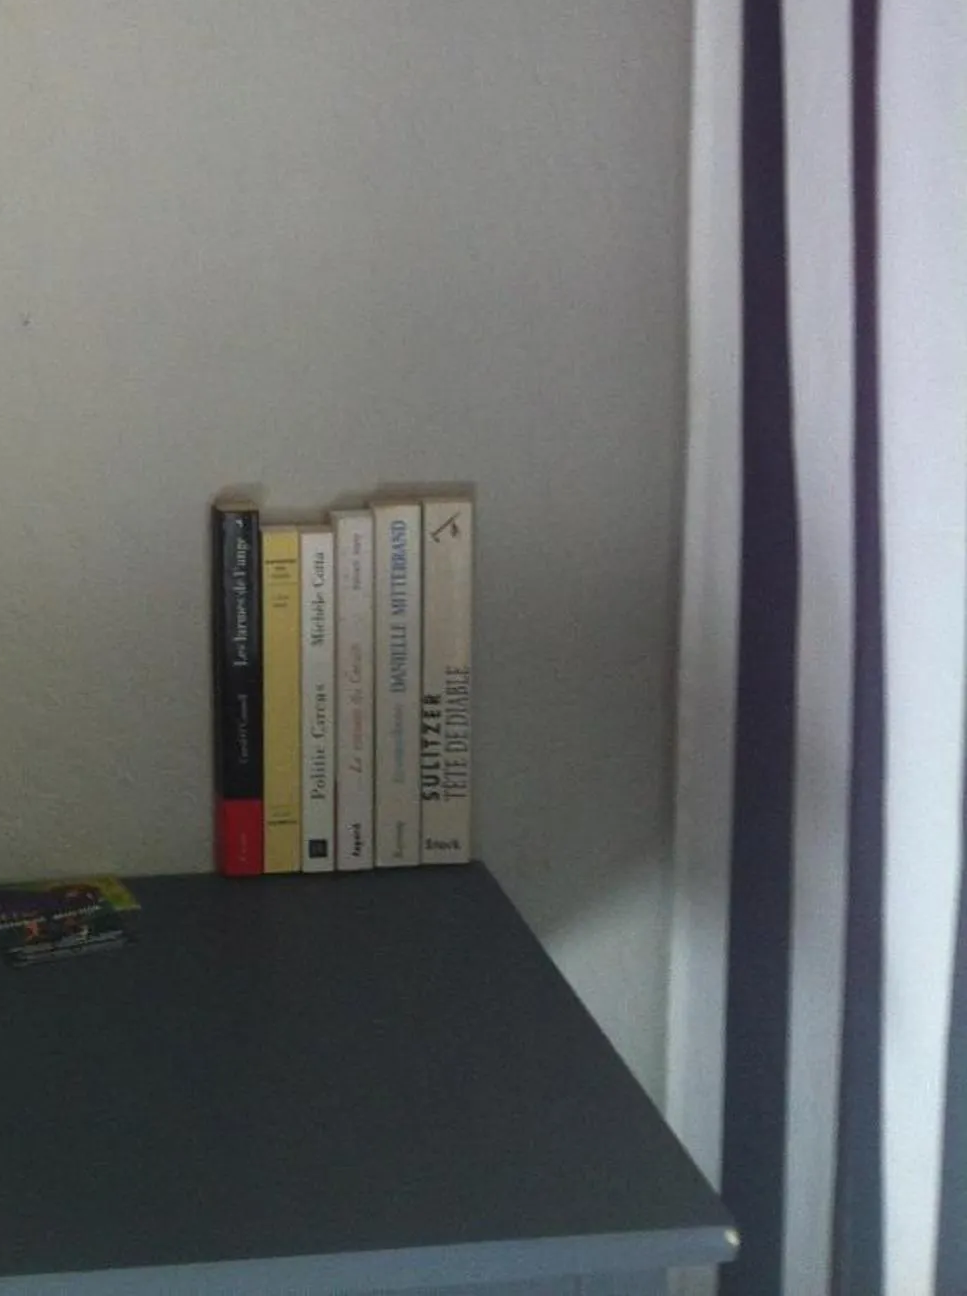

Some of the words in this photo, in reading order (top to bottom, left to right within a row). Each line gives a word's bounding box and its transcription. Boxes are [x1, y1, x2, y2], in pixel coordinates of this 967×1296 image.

[310, 551, 326, 588] Cotta
[389, 520, 408, 616] MITTERRAND
[233, 597, 248, 642] larmes
[309, 592, 326, 646] Michèle
[234, 644, 248, 666] Les
[390, 624, 408, 693] DANIELLE
[309, 683, 326, 739] Circus
[444, 666, 469, 726] DIABLE
[422, 693, 441, 802] SULITZER
[445, 732, 469, 753] DE
[309, 747, 326, 801] Politic
[441, 757, 469, 803] TÊTE
